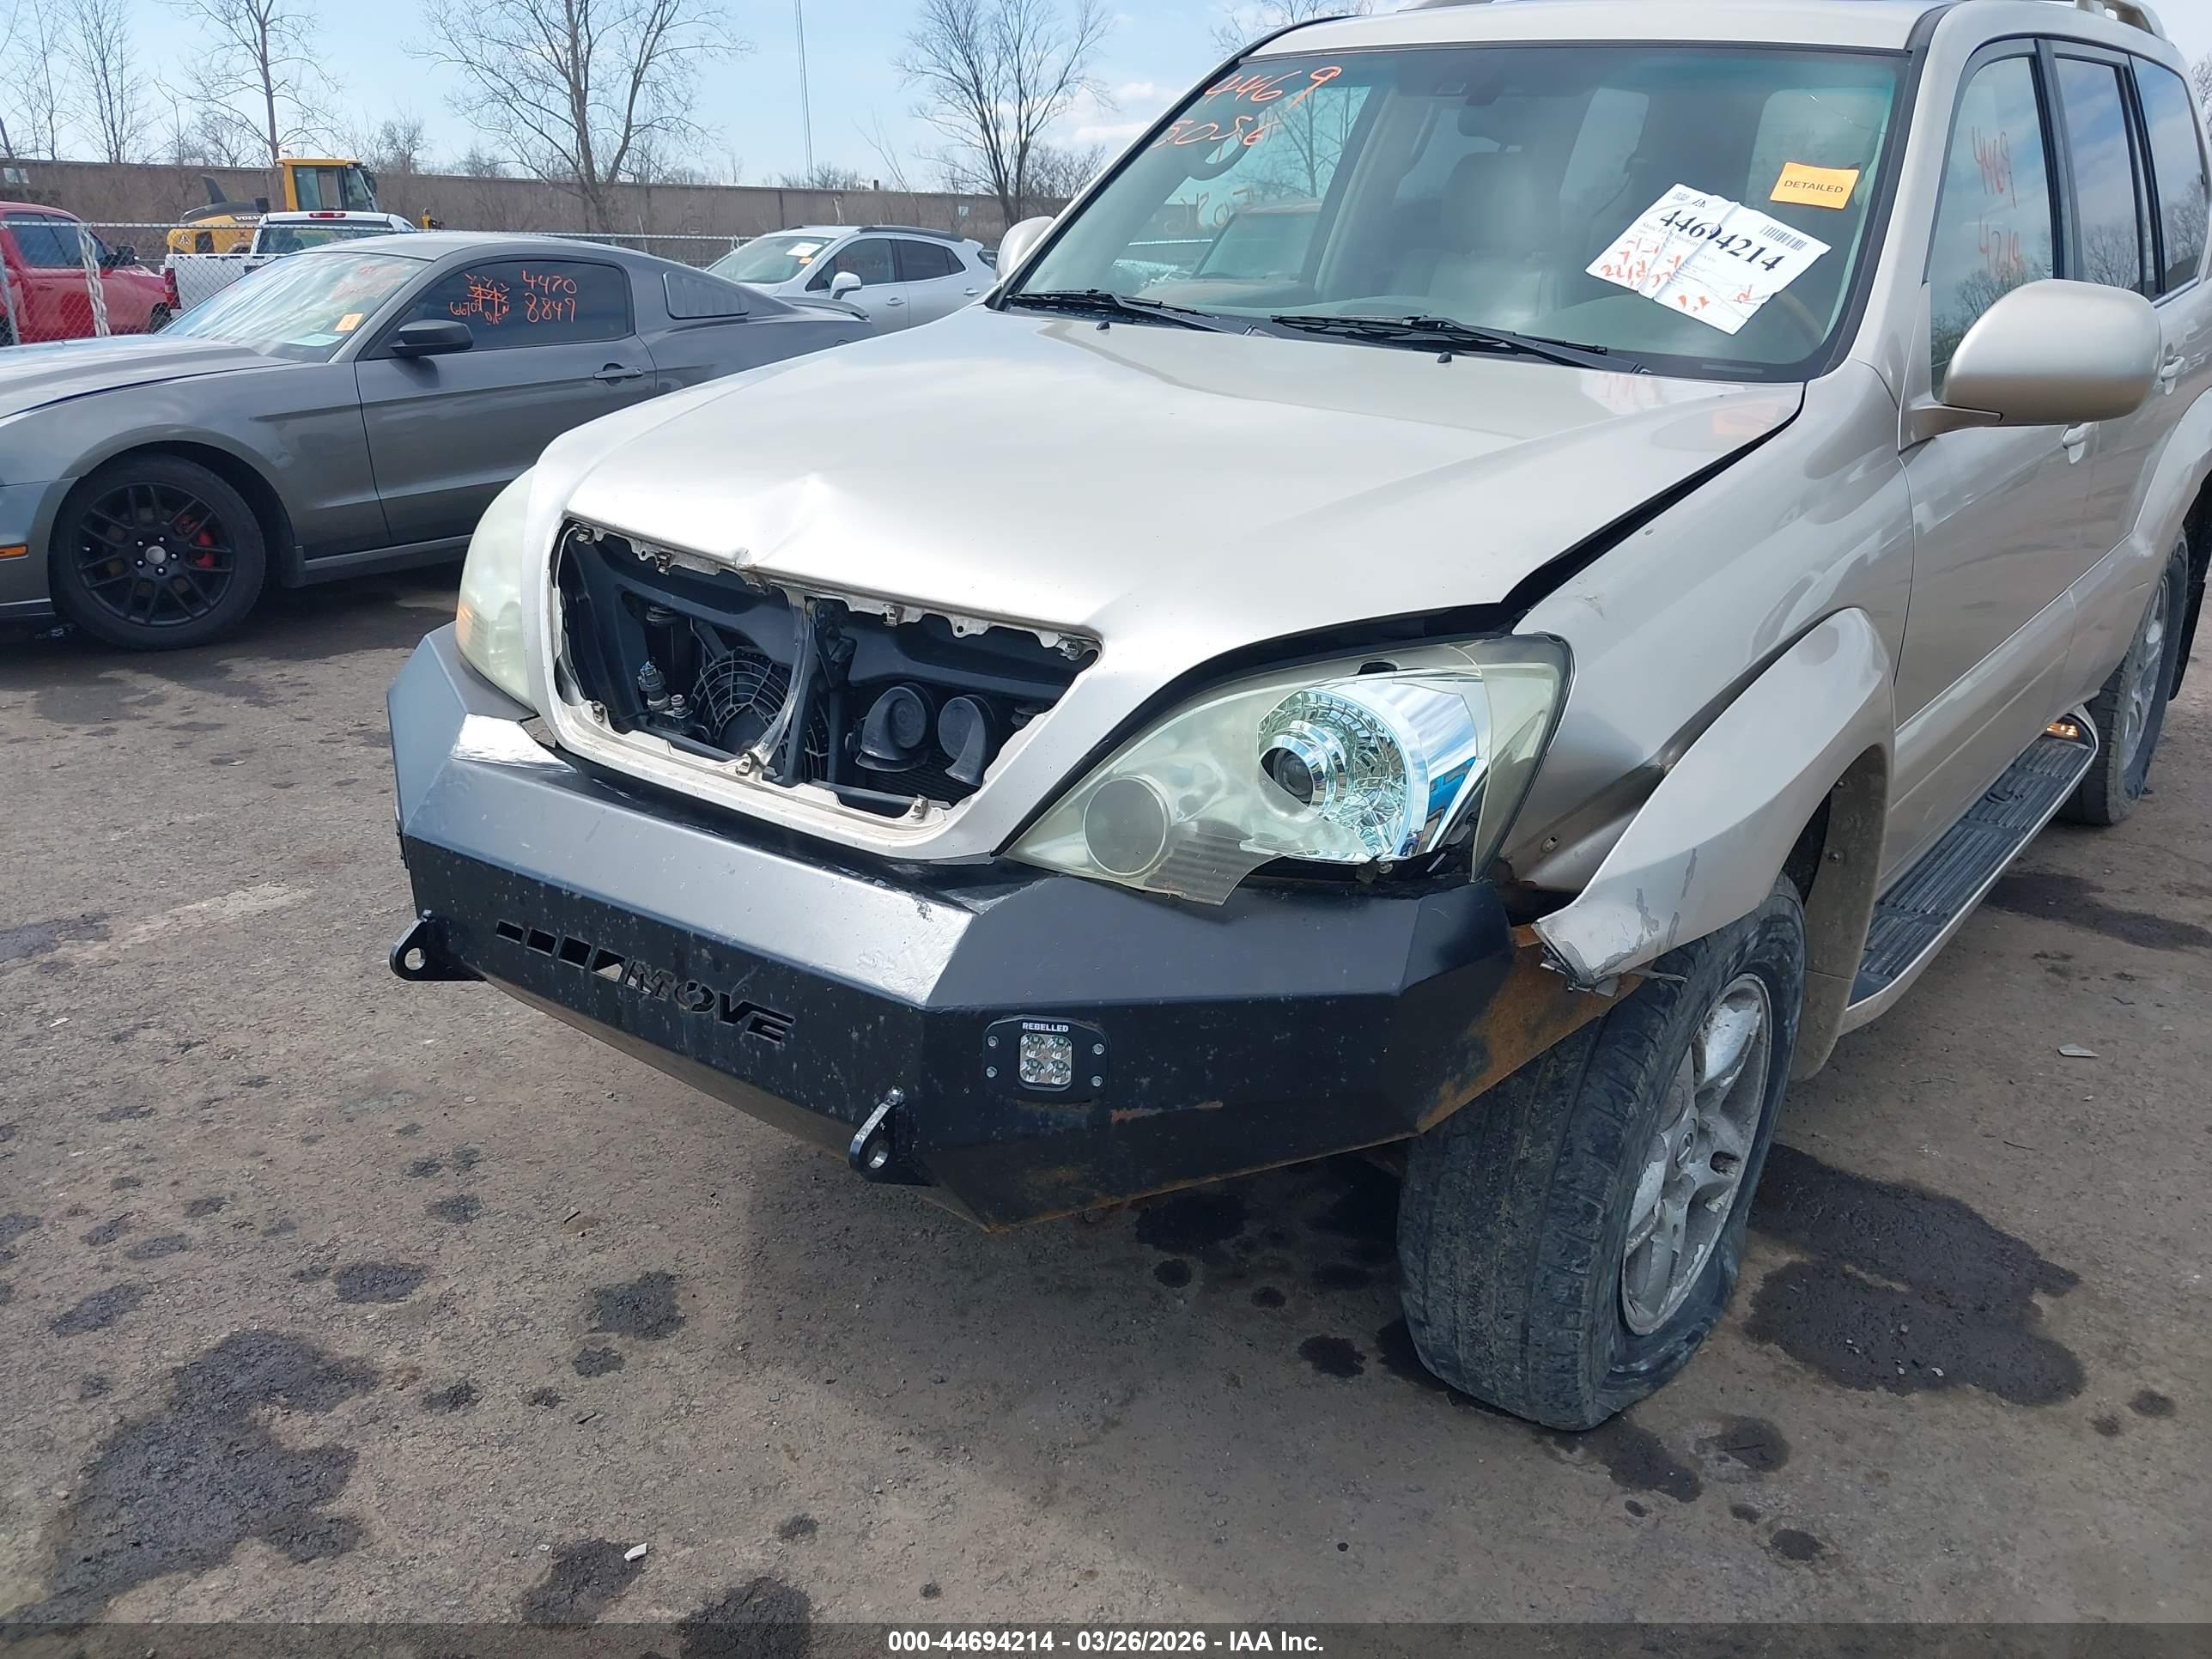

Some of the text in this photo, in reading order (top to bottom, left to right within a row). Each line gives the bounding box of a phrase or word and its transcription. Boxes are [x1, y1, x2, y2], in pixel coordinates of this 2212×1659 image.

[1784, 179, 1844, 193] DETAILED
[1660, 210, 1786, 271] 44694214
[522, 269, 577, 295] 4470
[524, 292, 576, 323] 8849
[625, 960, 796, 1044] MOVE
[1022, 1022, 1069, 1033] REBELLED
